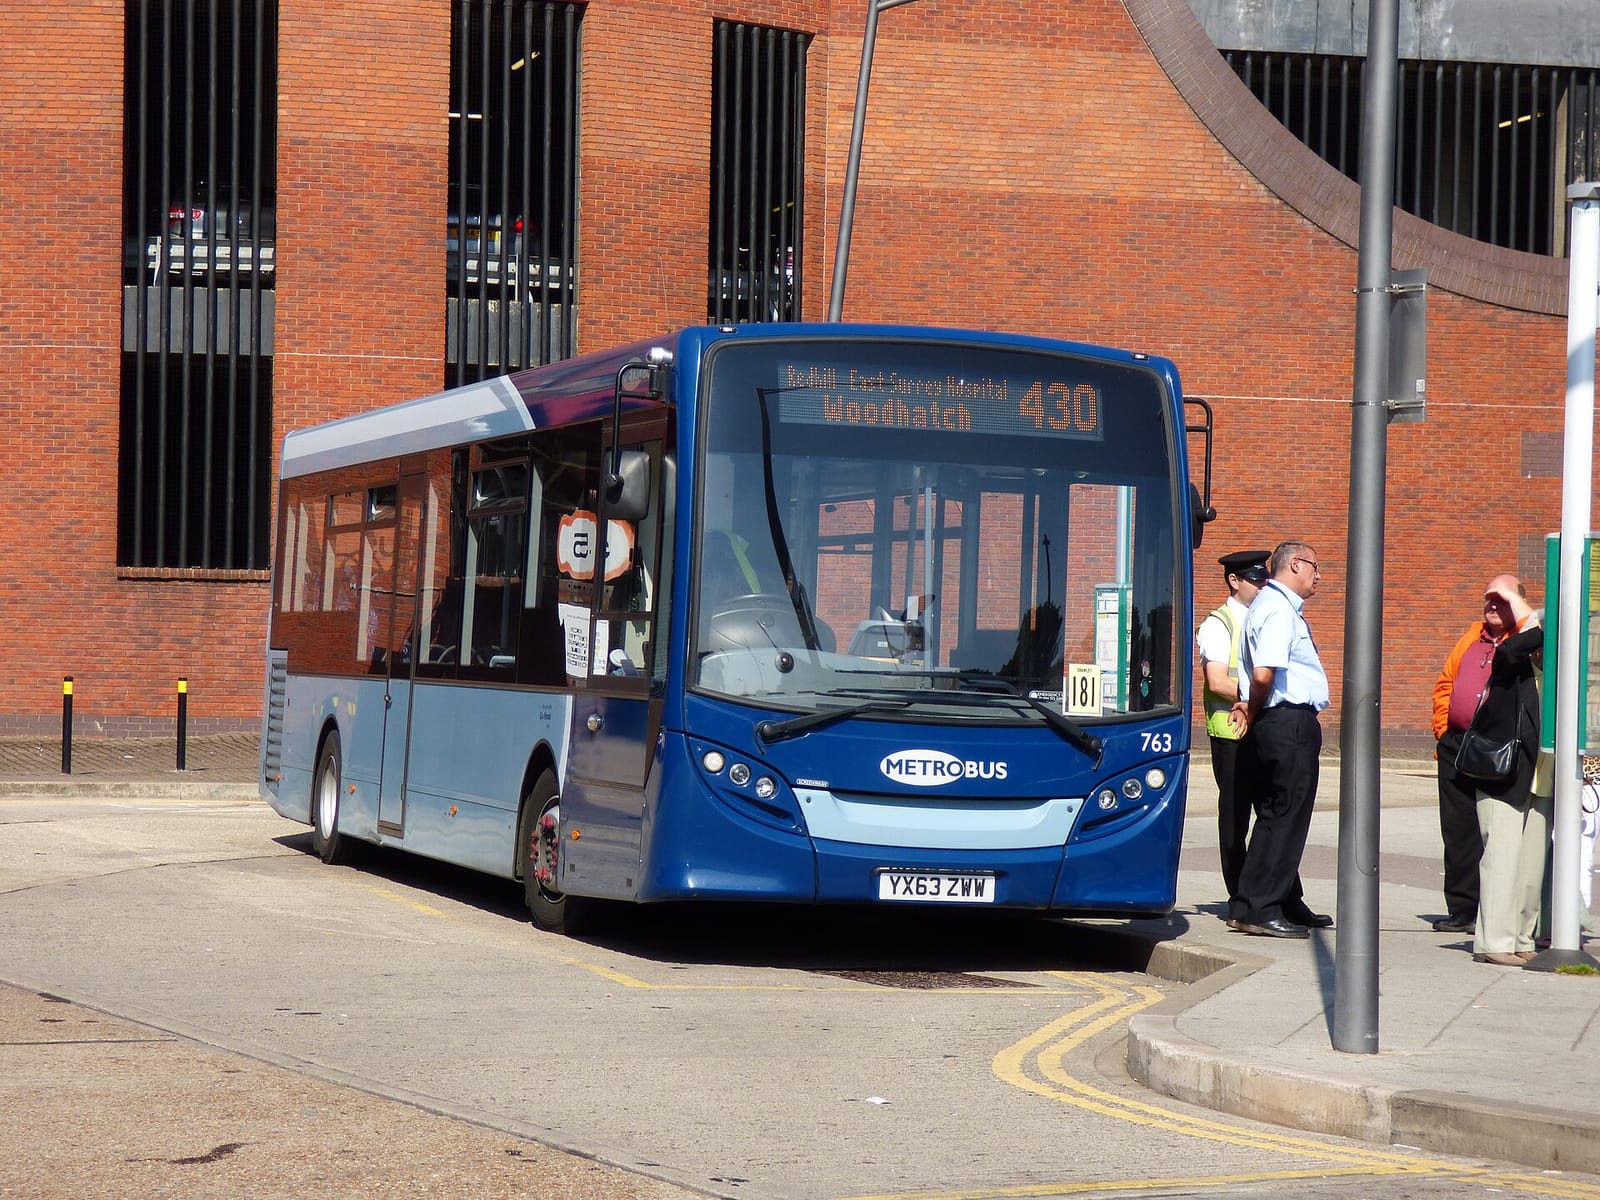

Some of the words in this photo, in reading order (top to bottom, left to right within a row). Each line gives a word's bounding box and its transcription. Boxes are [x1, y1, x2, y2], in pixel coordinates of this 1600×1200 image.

[787, 364, 836, 389] Redhill
[850, 369, 884, 393] East
[889, 371, 942, 396] Surrey
[947, 375, 1007, 400] Hospital
[824, 394, 971, 430] Woodhatch
[1018, 380, 1097, 432] 430
[1073, 676, 1095, 707] 181
[1141, 732, 1172, 753] 763
[886, 758, 1008, 780] METROBUS
[889, 876, 941, 896] YX63
[947, 878, 986, 897] ZWW
